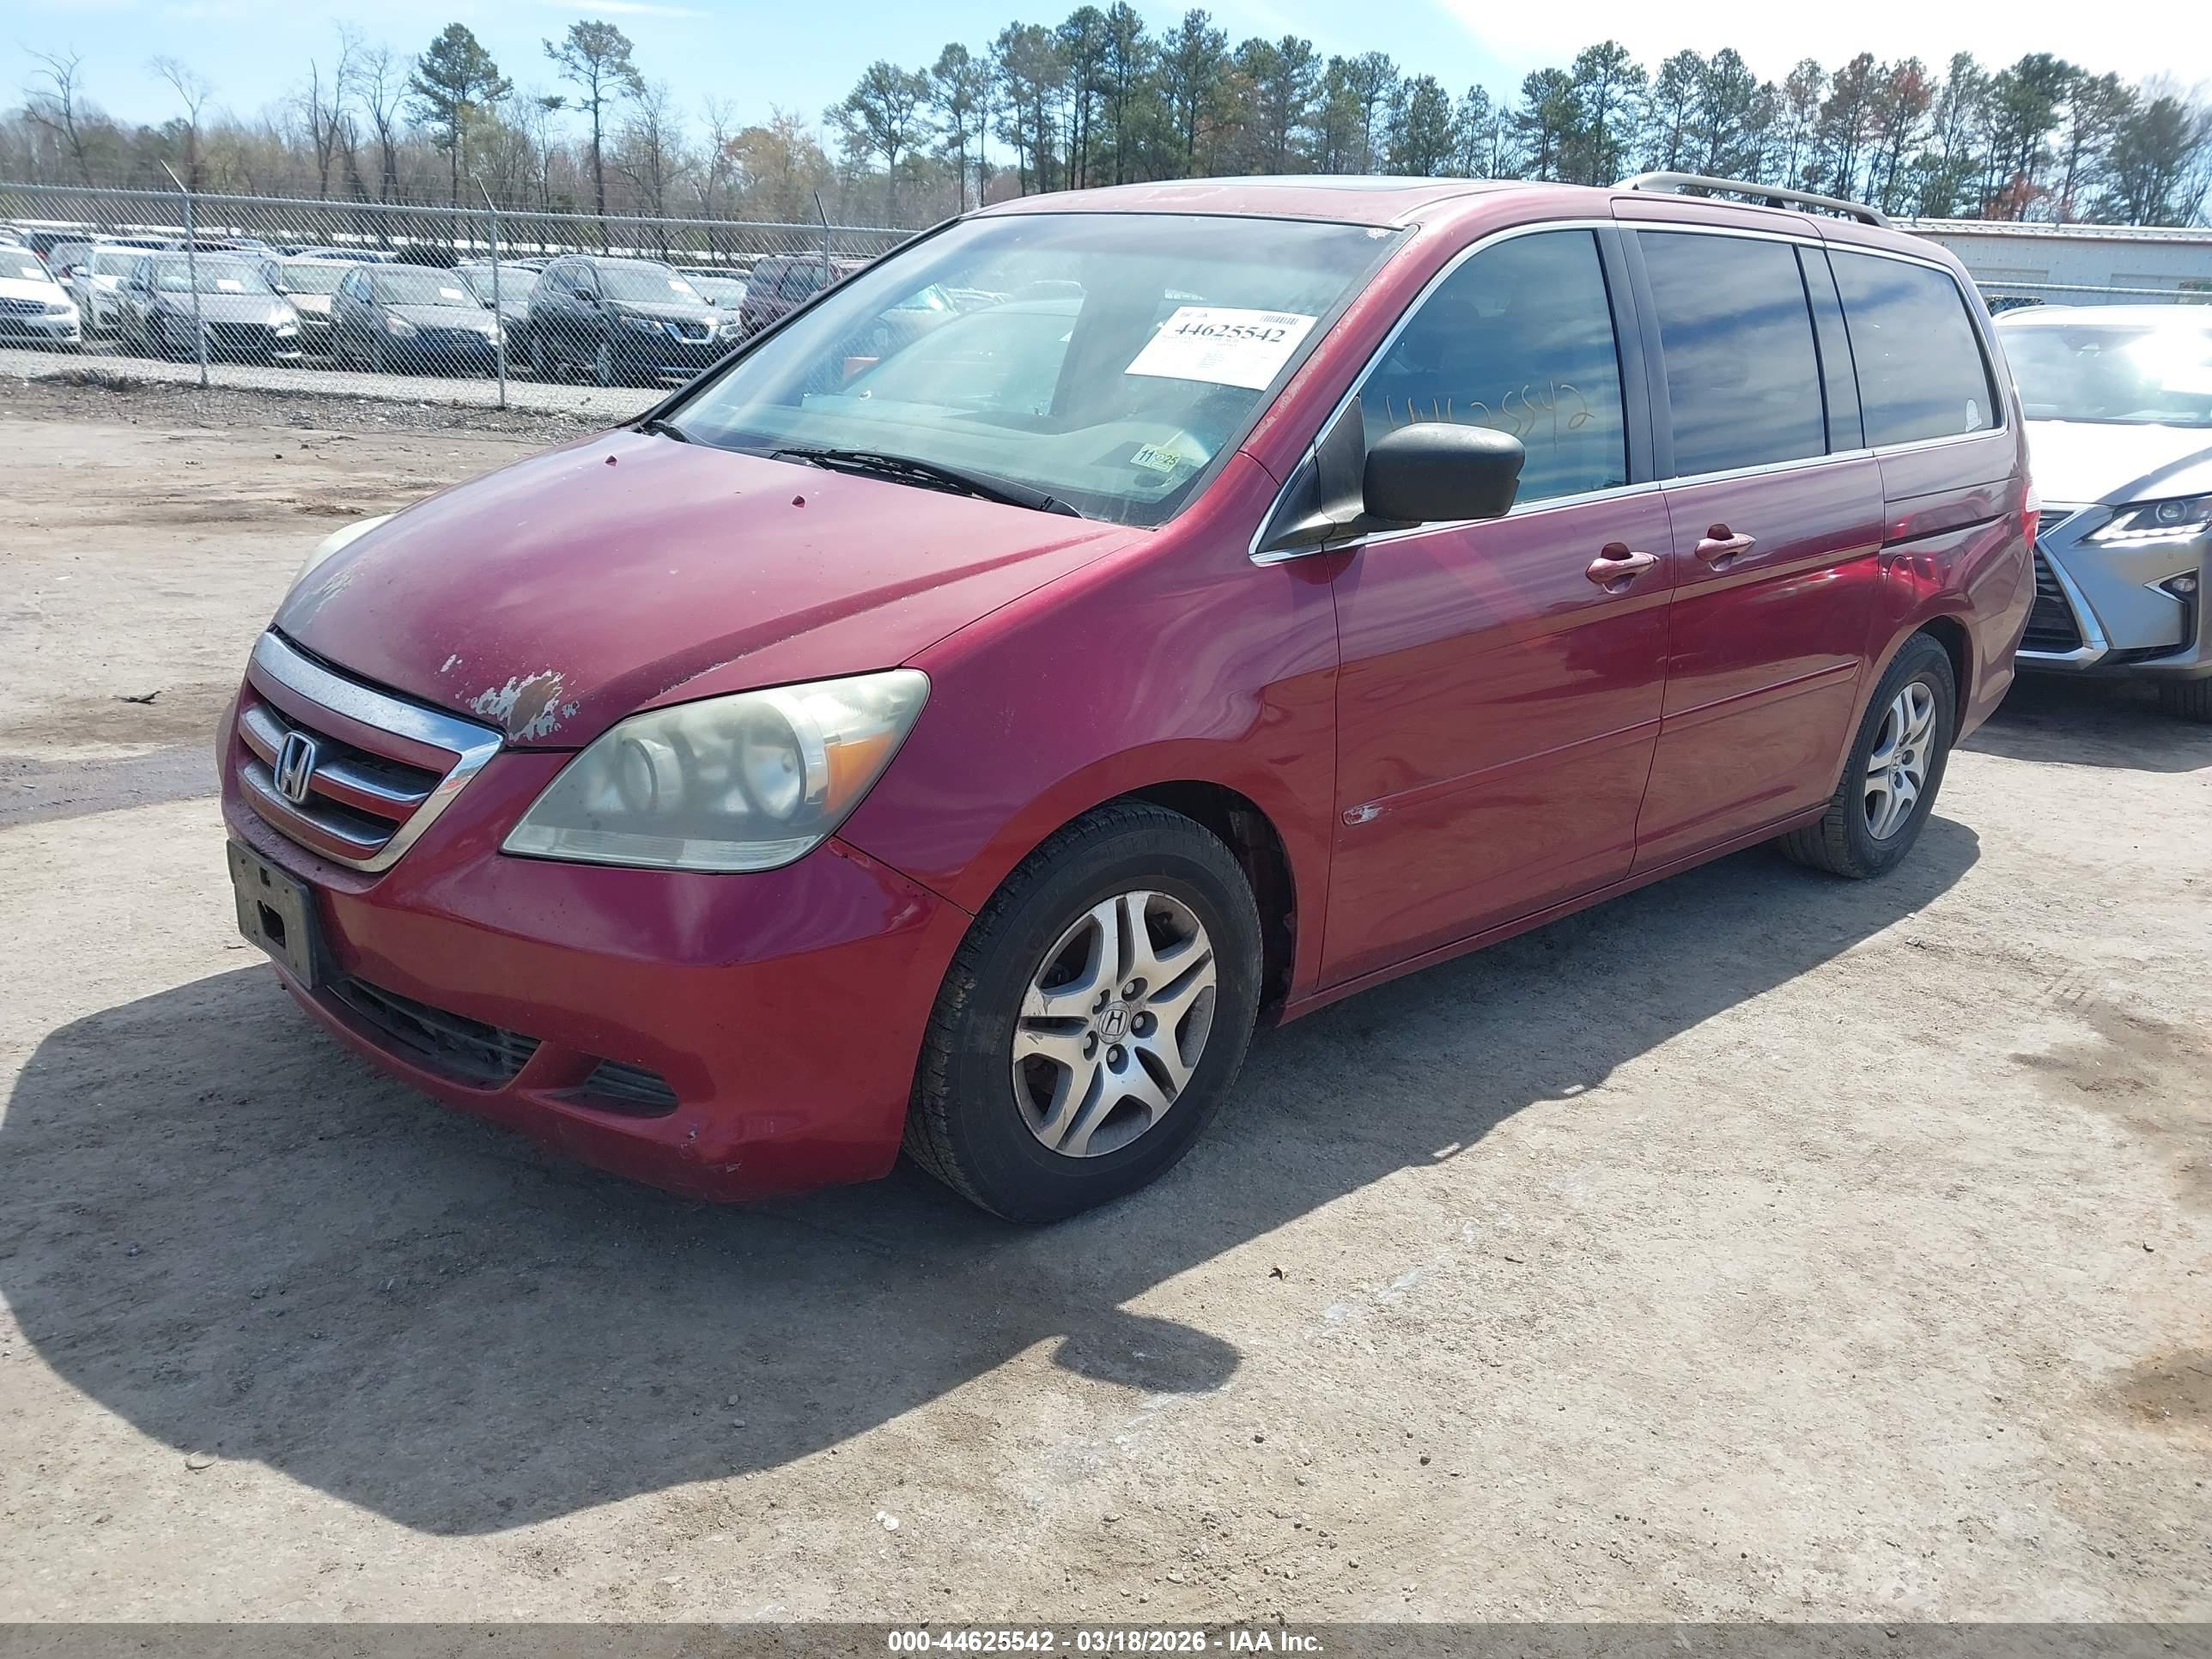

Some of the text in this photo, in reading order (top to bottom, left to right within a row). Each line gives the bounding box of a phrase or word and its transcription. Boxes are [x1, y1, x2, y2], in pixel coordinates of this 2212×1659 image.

[1175, 323, 1285, 343] 44625542
[1139, 449, 1179, 465] 11 25
